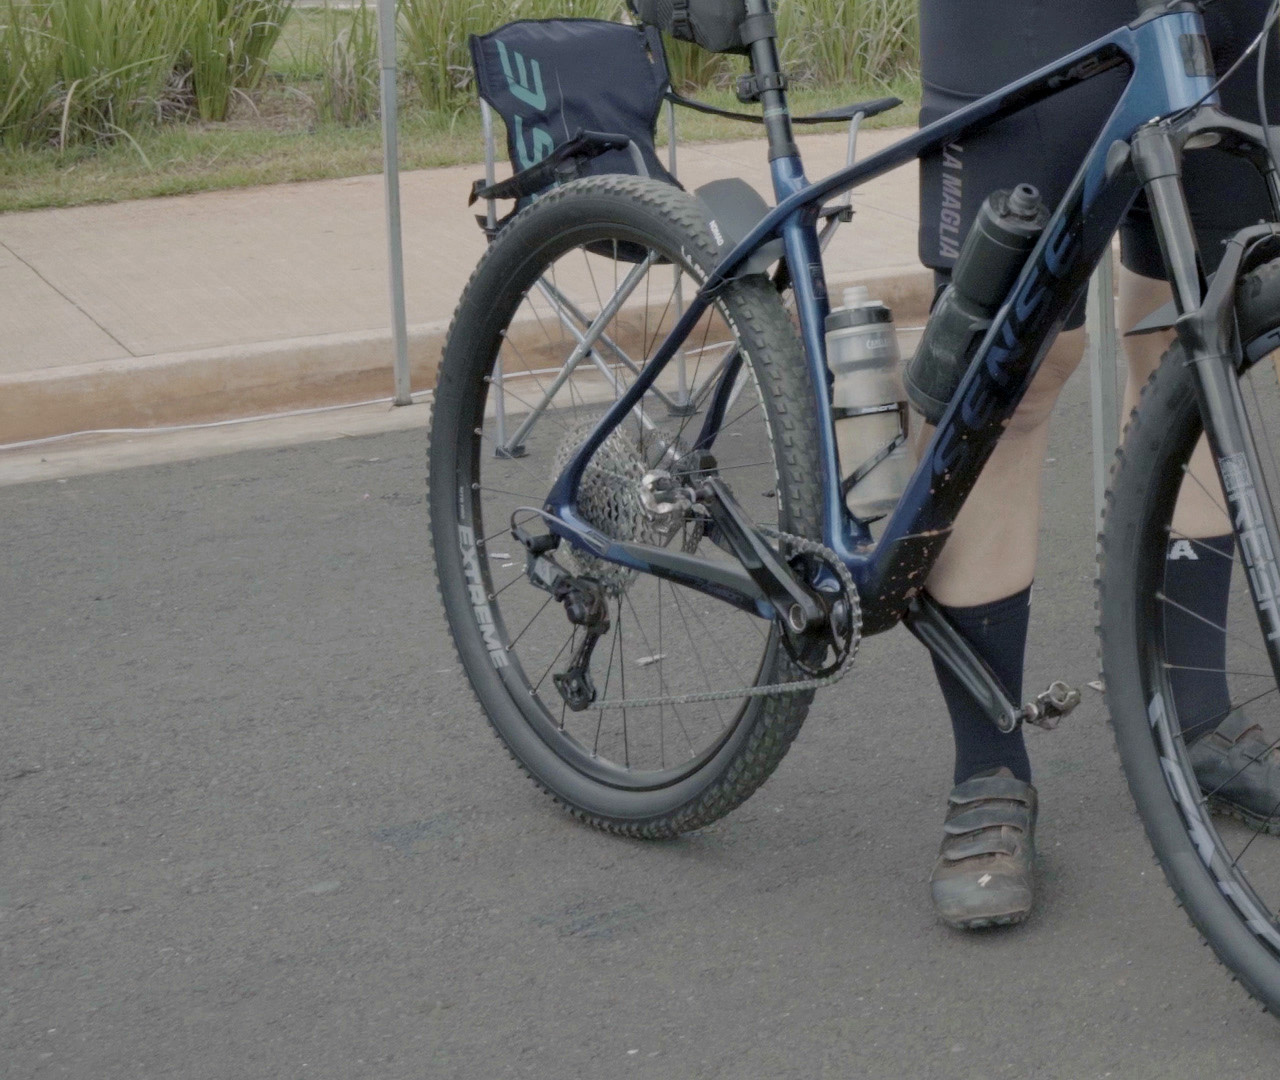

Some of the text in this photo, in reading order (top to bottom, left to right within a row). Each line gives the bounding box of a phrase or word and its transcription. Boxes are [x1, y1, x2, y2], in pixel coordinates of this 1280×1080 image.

[709, 220, 724, 246] NOMAD
[939, 171, 963, 259] MAGLIA
[934, 216, 1082, 476] SENSE
[458, 524, 510, 669] EXTREME
